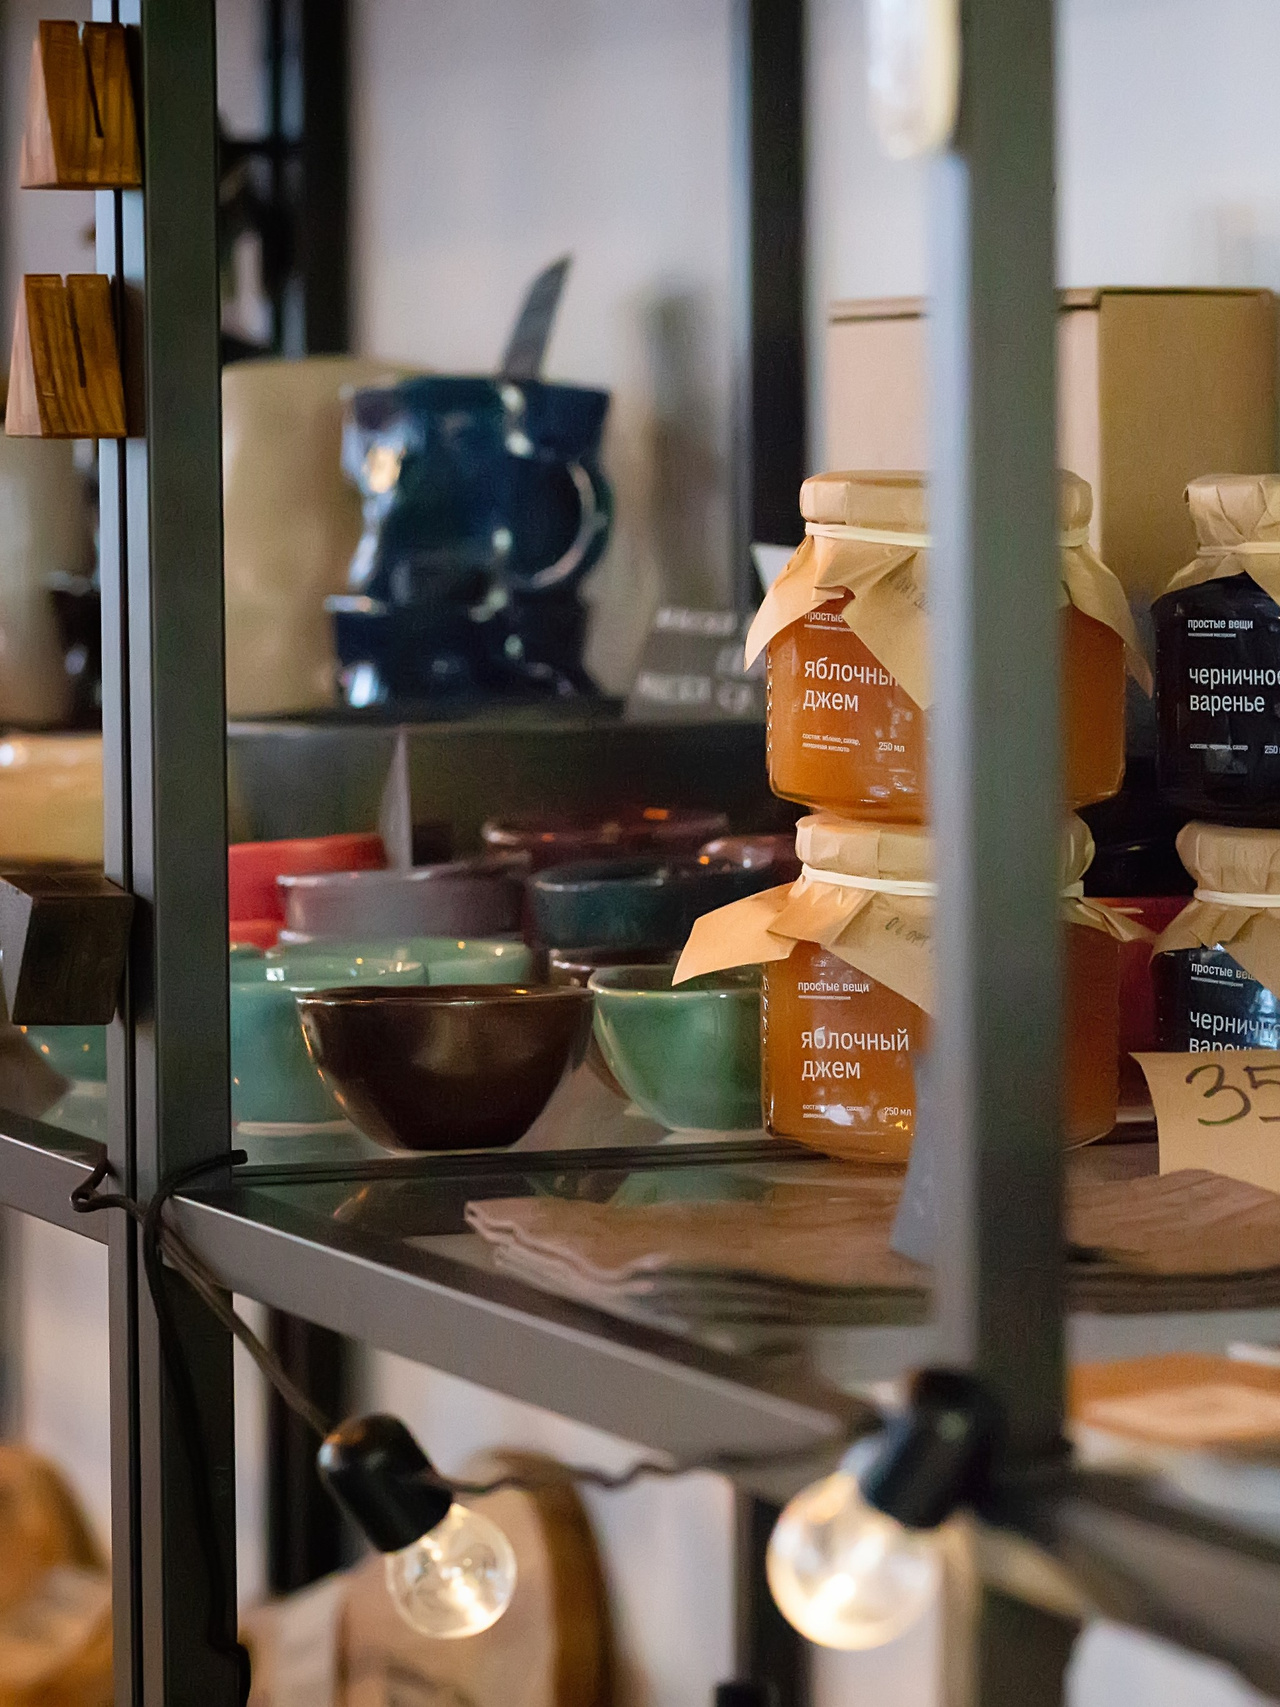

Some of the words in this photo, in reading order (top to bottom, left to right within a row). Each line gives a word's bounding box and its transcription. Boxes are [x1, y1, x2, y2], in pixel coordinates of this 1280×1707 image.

[1187, 619, 1226, 631] простые
[1228, 619, 1254, 631] вещи
[802, 689, 860, 713] джем
[1189, 694, 1266, 717] варенье
[878, 741, 893, 752] 250
[1264, 745, 1278, 755] 250
[1191, 963, 1234, 977] простые
[797, 981, 840, 994] простые
[842, 983, 870, 994] вещи
[801, 1026, 909, 1051] яблочный
[801, 1060, 861, 1081] джем
[883, 1106, 899, 1117] 250
[900, 1109, 912, 1118] мл
